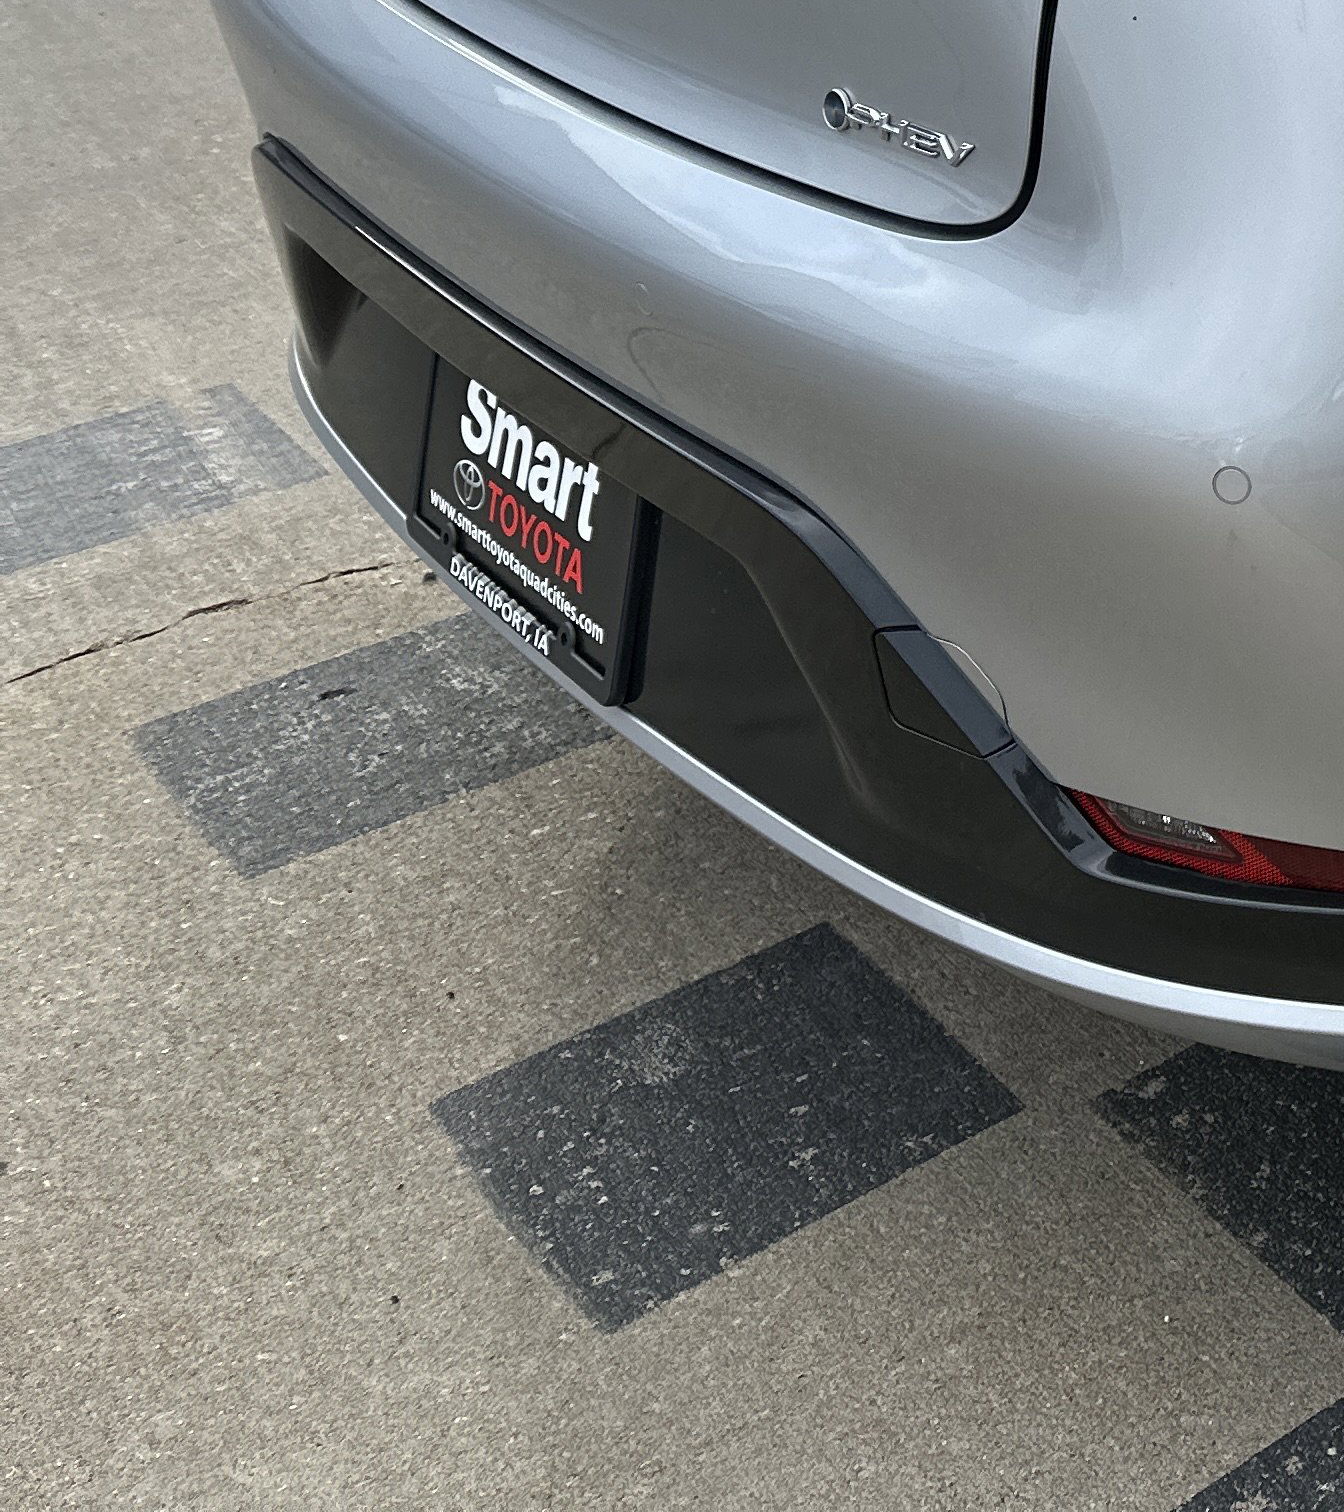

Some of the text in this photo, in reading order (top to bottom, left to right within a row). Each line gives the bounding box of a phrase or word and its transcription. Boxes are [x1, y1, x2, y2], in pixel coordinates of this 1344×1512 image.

[849, 103, 976, 167] PHEV
[460, 379, 599, 541] Smart
[430, 490, 604, 644] www.smarttoyotaquadcities.com
[487, 481, 584, 594] TOYOTA
[450, 557, 550, 656] DAVENPORT, IA
